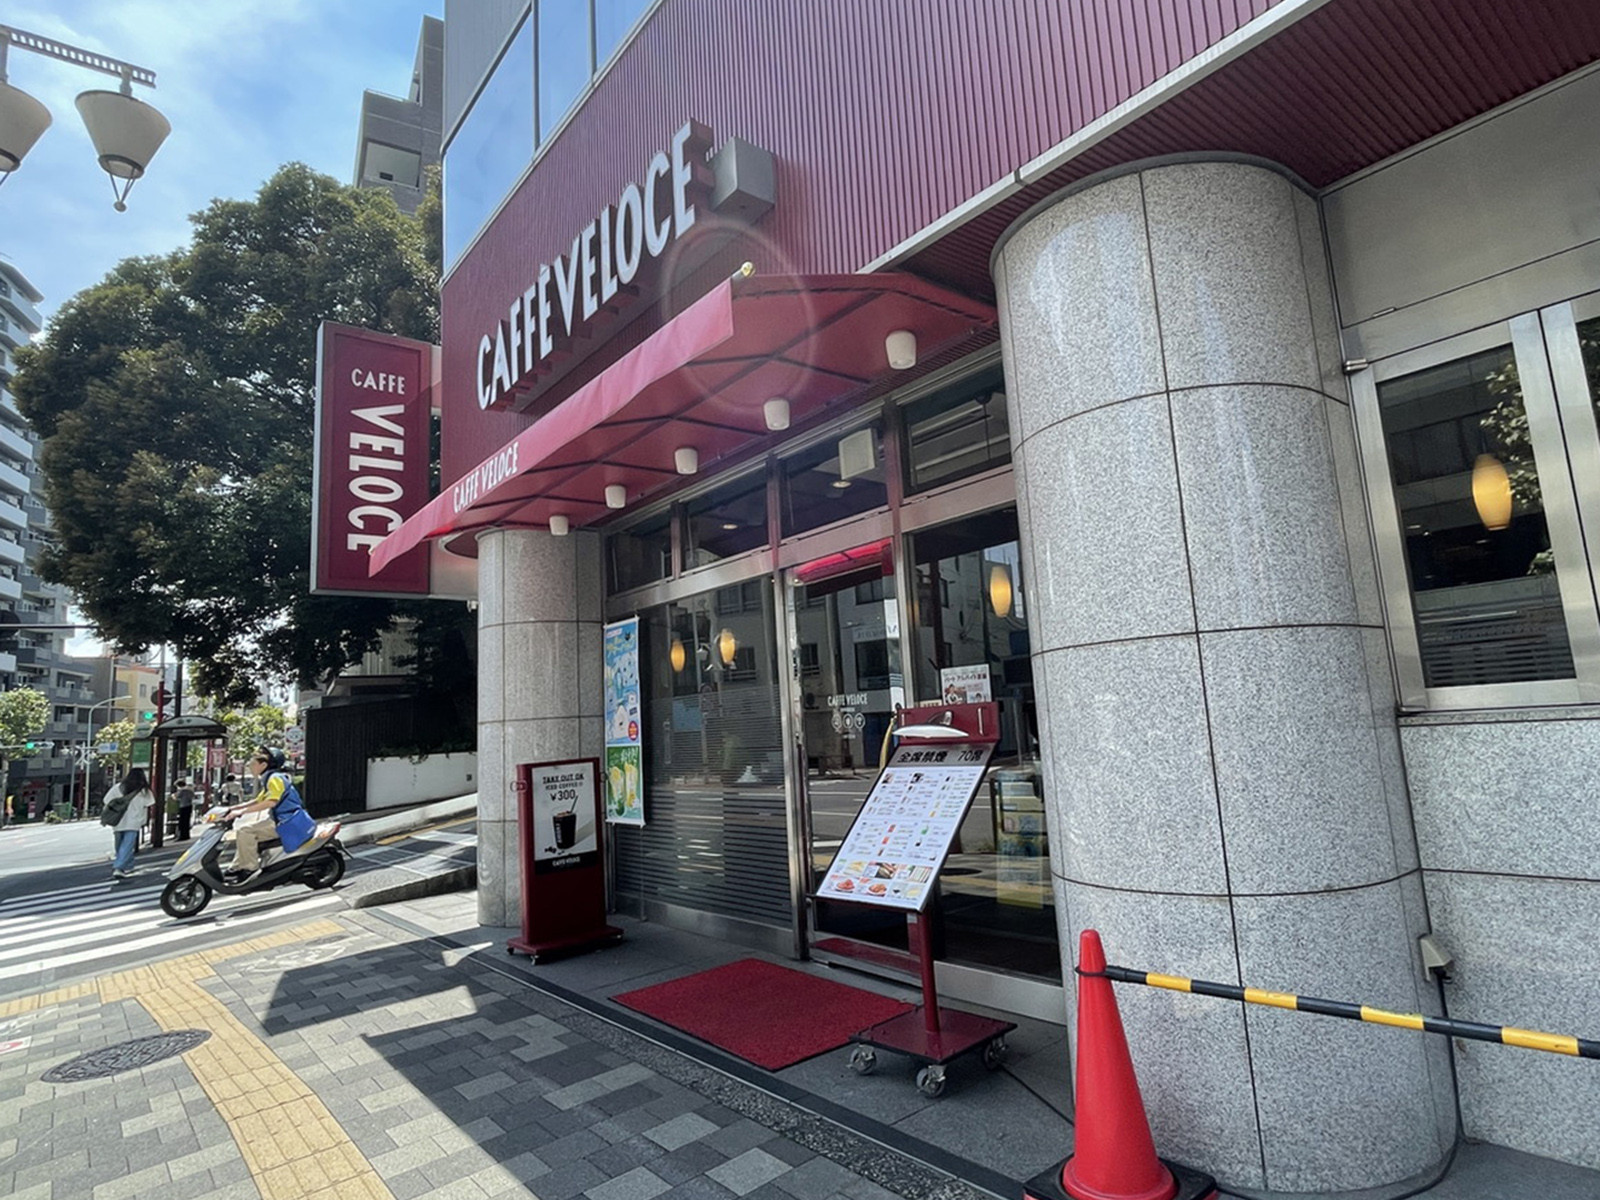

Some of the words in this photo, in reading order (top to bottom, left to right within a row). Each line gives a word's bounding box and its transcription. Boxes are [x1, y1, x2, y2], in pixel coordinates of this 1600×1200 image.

[554, 120, 696, 337] VELOCE
[351, 367, 405, 395] CAFFE
[453, 470, 480, 514] CAFFE
[481, 441, 519, 493] VELOCE
